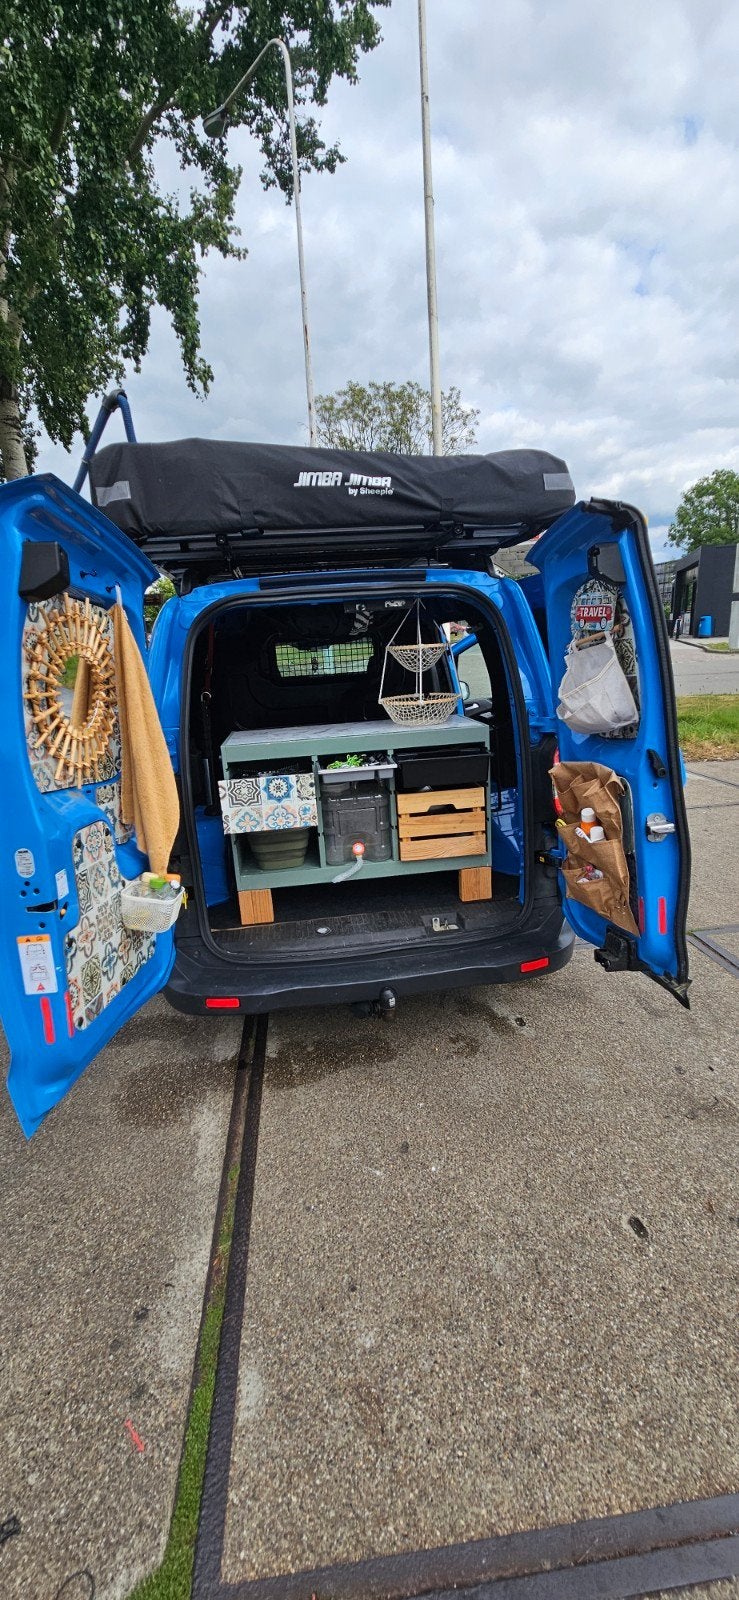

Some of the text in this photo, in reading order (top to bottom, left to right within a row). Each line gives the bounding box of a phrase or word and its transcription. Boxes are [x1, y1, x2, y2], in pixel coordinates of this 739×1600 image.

[294, 472, 392, 487] JIMBA JIMBA
[348, 487, 358, 496] by
[579, 606, 607, 617] TRAVEL
